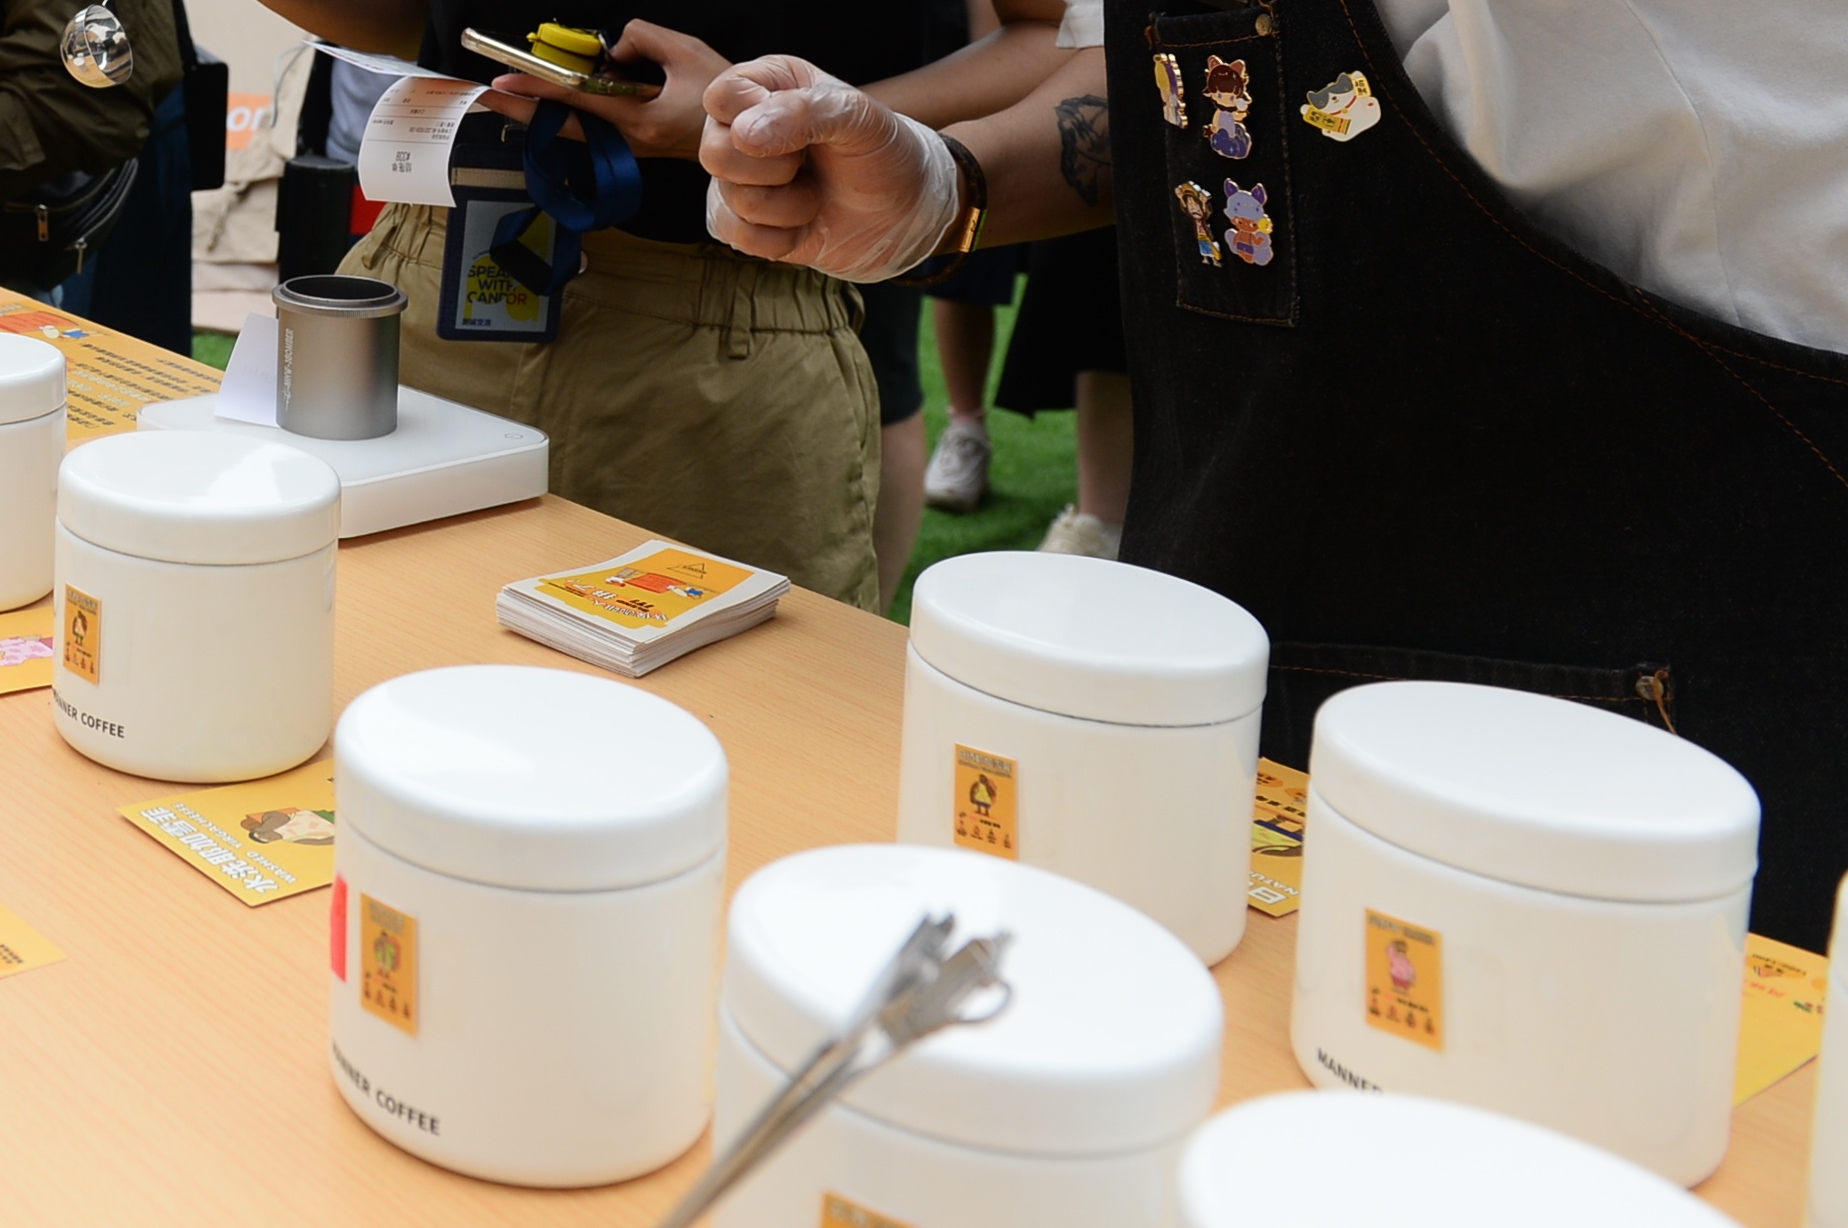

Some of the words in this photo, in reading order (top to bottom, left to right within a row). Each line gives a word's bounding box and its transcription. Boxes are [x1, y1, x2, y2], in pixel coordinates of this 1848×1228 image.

[80, 712, 126, 740] COFFEE
[245, 850, 297, 884] WASHED
[374, 1087, 441, 1137] COFFEE
